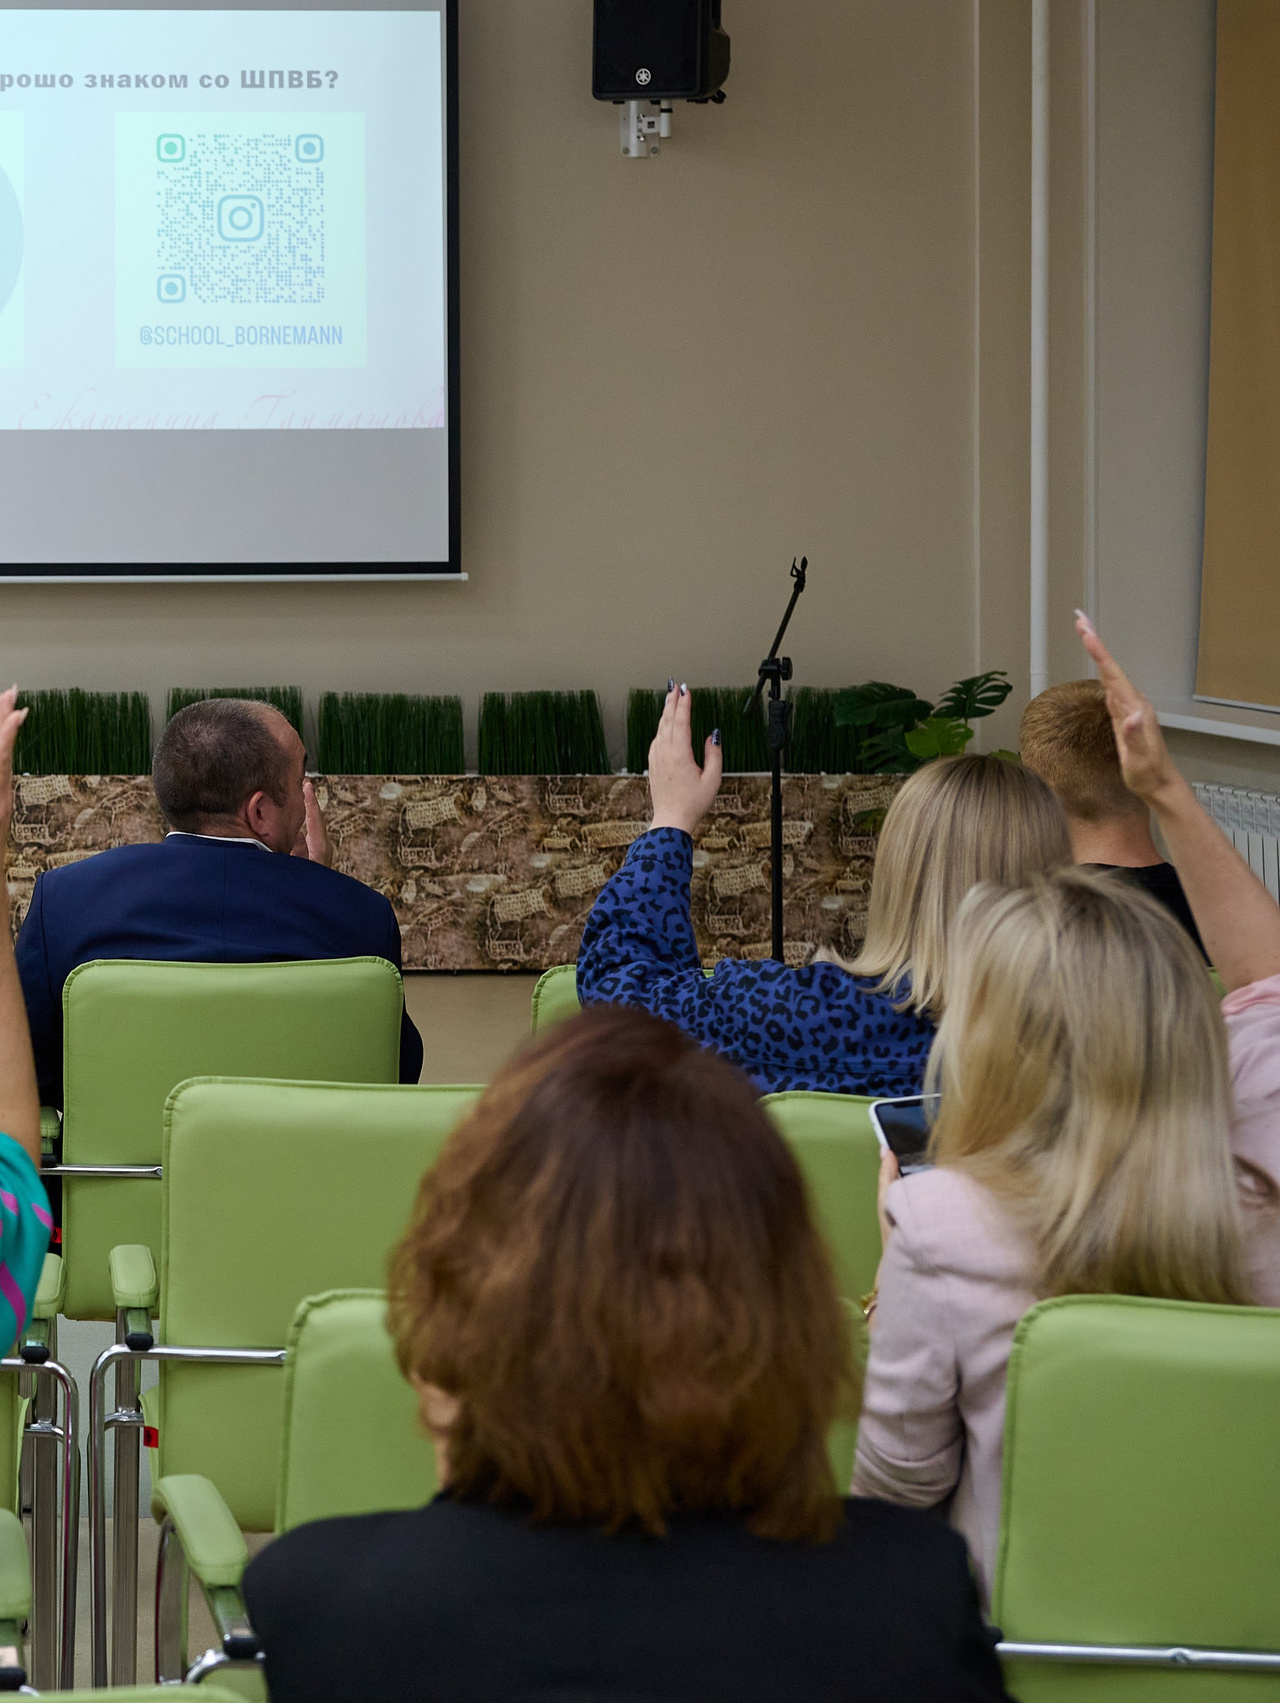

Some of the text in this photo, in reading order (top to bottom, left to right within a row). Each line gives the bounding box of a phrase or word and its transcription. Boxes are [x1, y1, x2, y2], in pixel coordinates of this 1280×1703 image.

[84, 73, 189, 88] знаком
[198, 73, 230, 88] со
[240, 69, 339, 89] ШПВБ?
[139, 324, 343, 348] @SCHOOL_BORNEMANN
